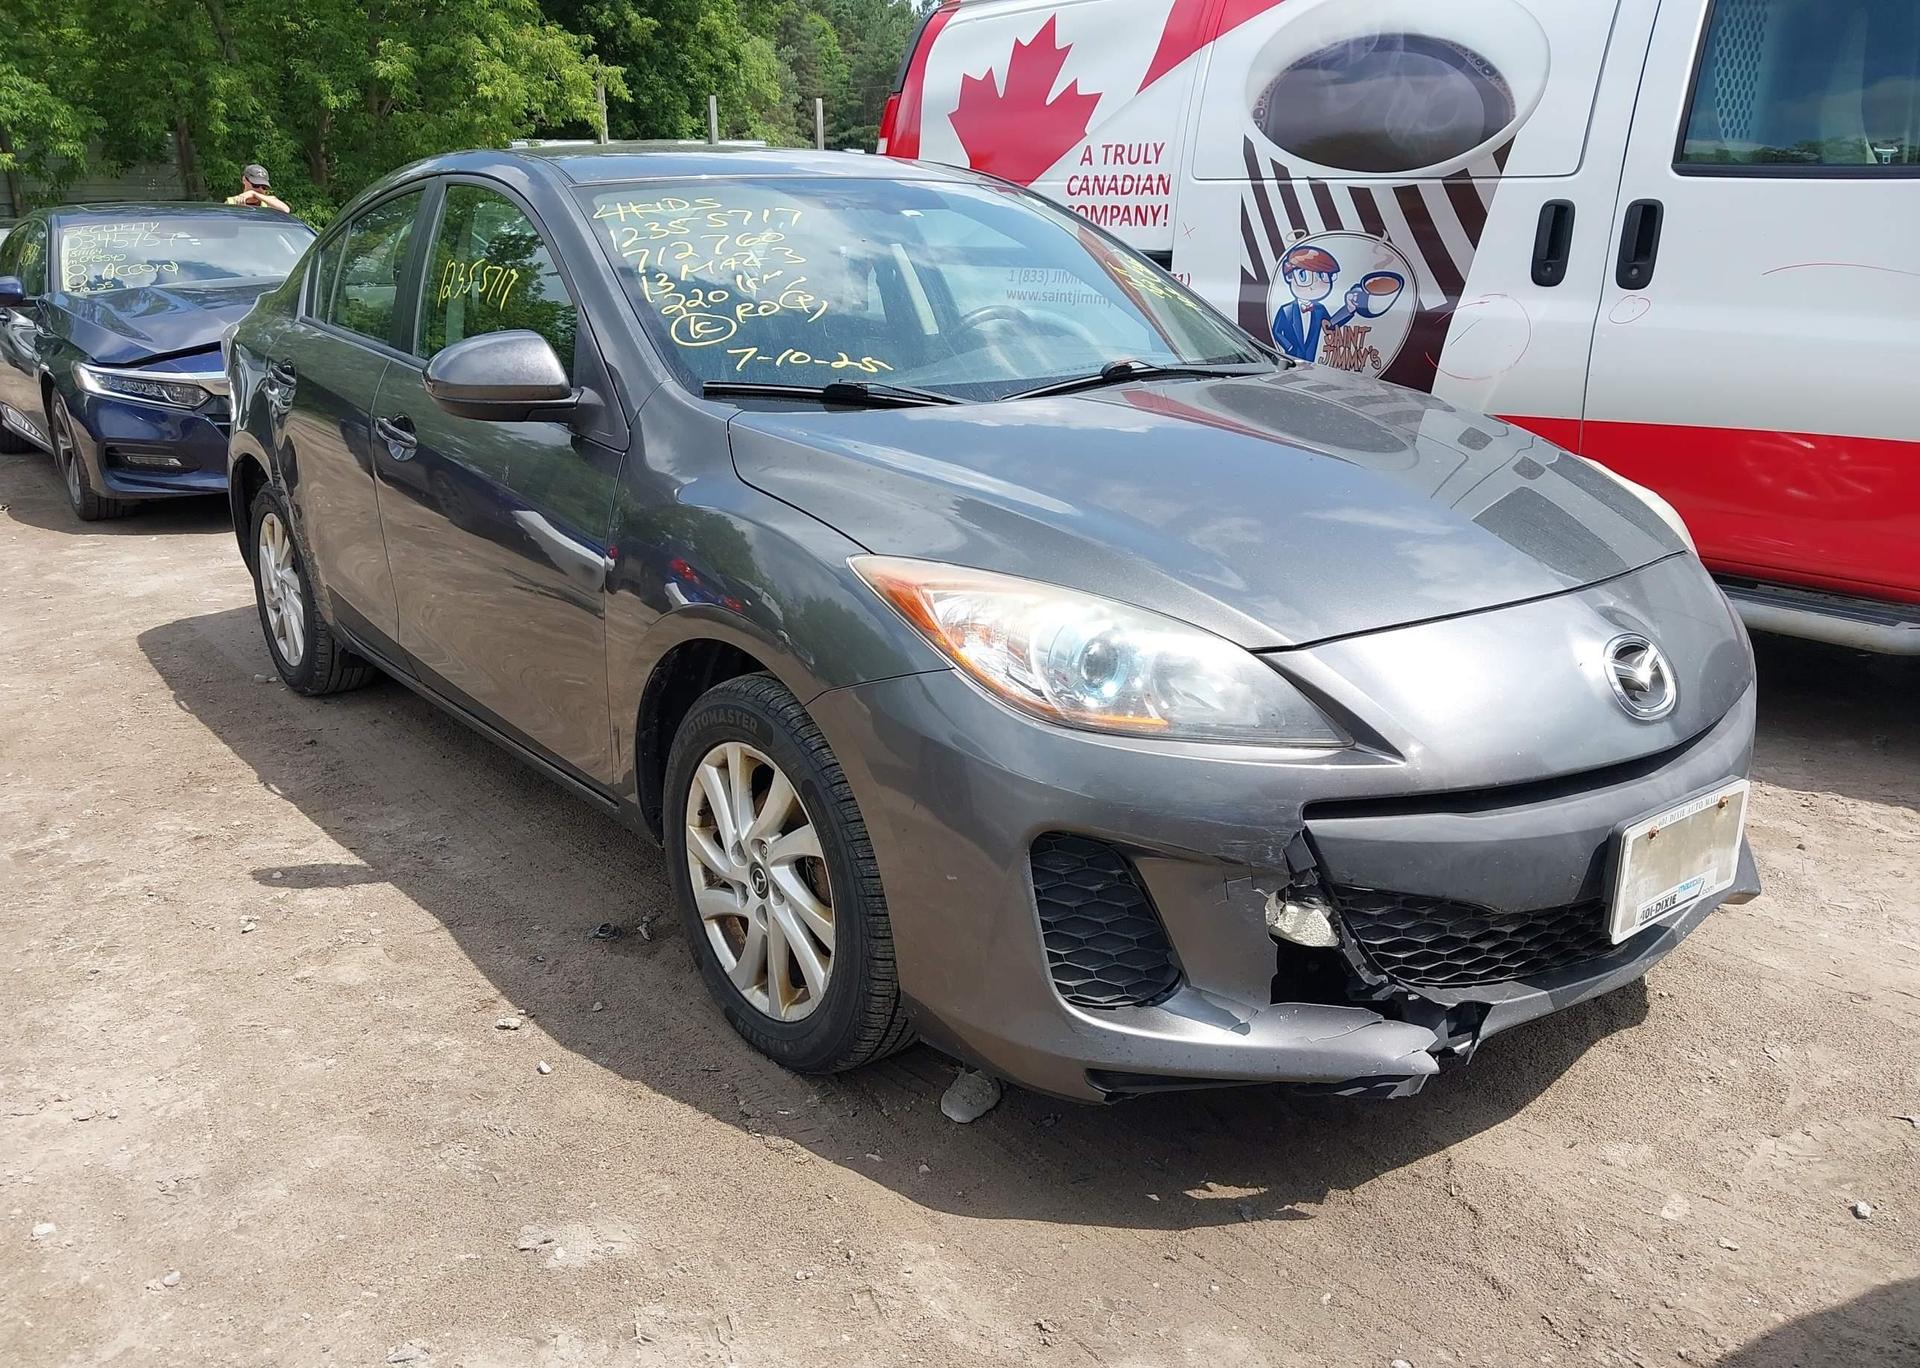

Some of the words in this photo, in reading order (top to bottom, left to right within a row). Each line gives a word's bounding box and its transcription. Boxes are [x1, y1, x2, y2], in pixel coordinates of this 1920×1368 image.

[1080, 144, 1094, 166] A
[1102, 142, 1166, 166] TRULY
[1066, 173, 1172, 196] CANADIAN
[1018, 268, 1050, 286] (833)
[1321, 319, 1372, 349] SAINT
[727, 347, 895, 373] 7-10-25
[1317, 345, 1382, 373] JIMMY'S
[1639, 893, 1678, 921] 401-DIXIE
